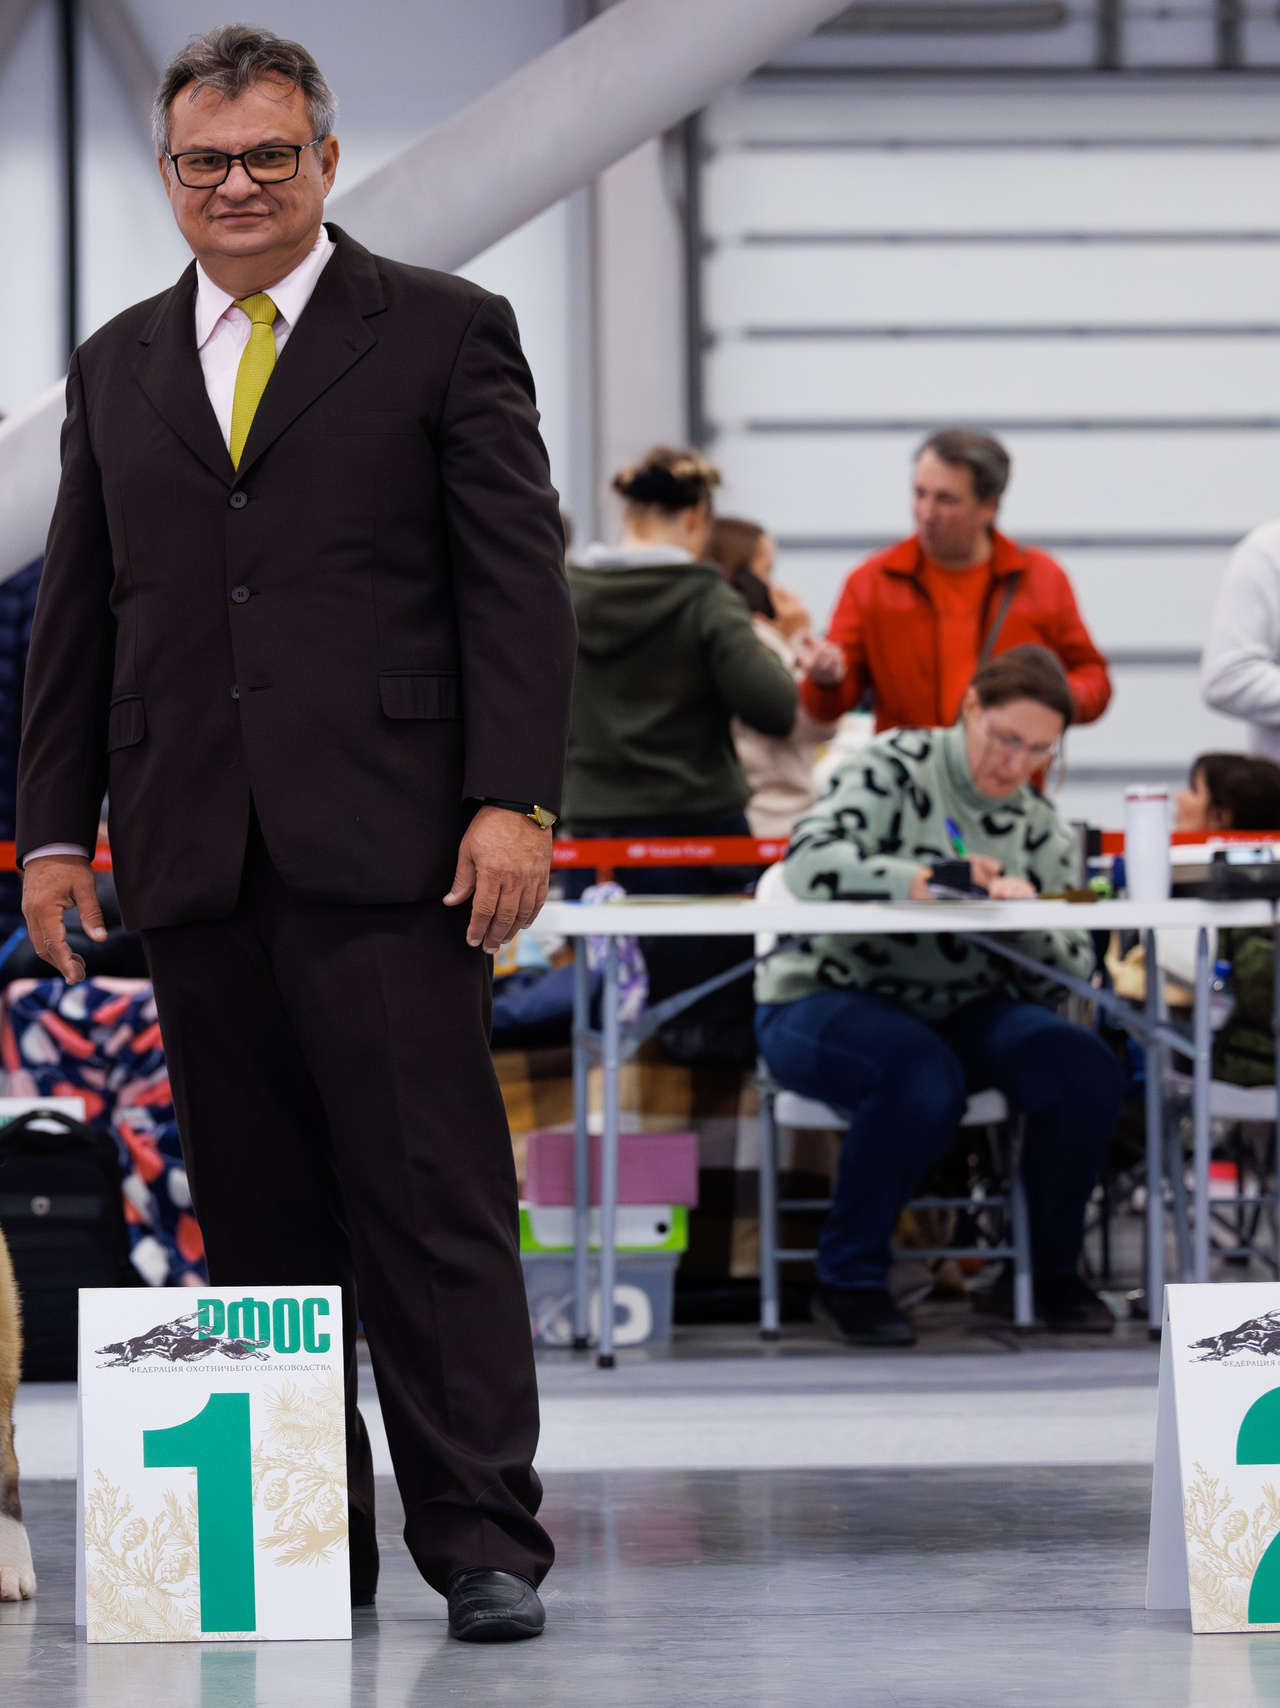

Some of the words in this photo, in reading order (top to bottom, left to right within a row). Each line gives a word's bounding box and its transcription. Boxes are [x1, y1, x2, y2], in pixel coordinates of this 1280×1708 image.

[197, 1297, 330, 1353] РФОС
[129, 1365, 183, 1373] ФЕДЕРАЦИЯ
[186, 1364, 252, 1373] ОХОТНИЧЬЕГО
[254, 1363, 332, 1372] СОБАКОВОДСТВА
[143, 1392, 256, 1632] 1
